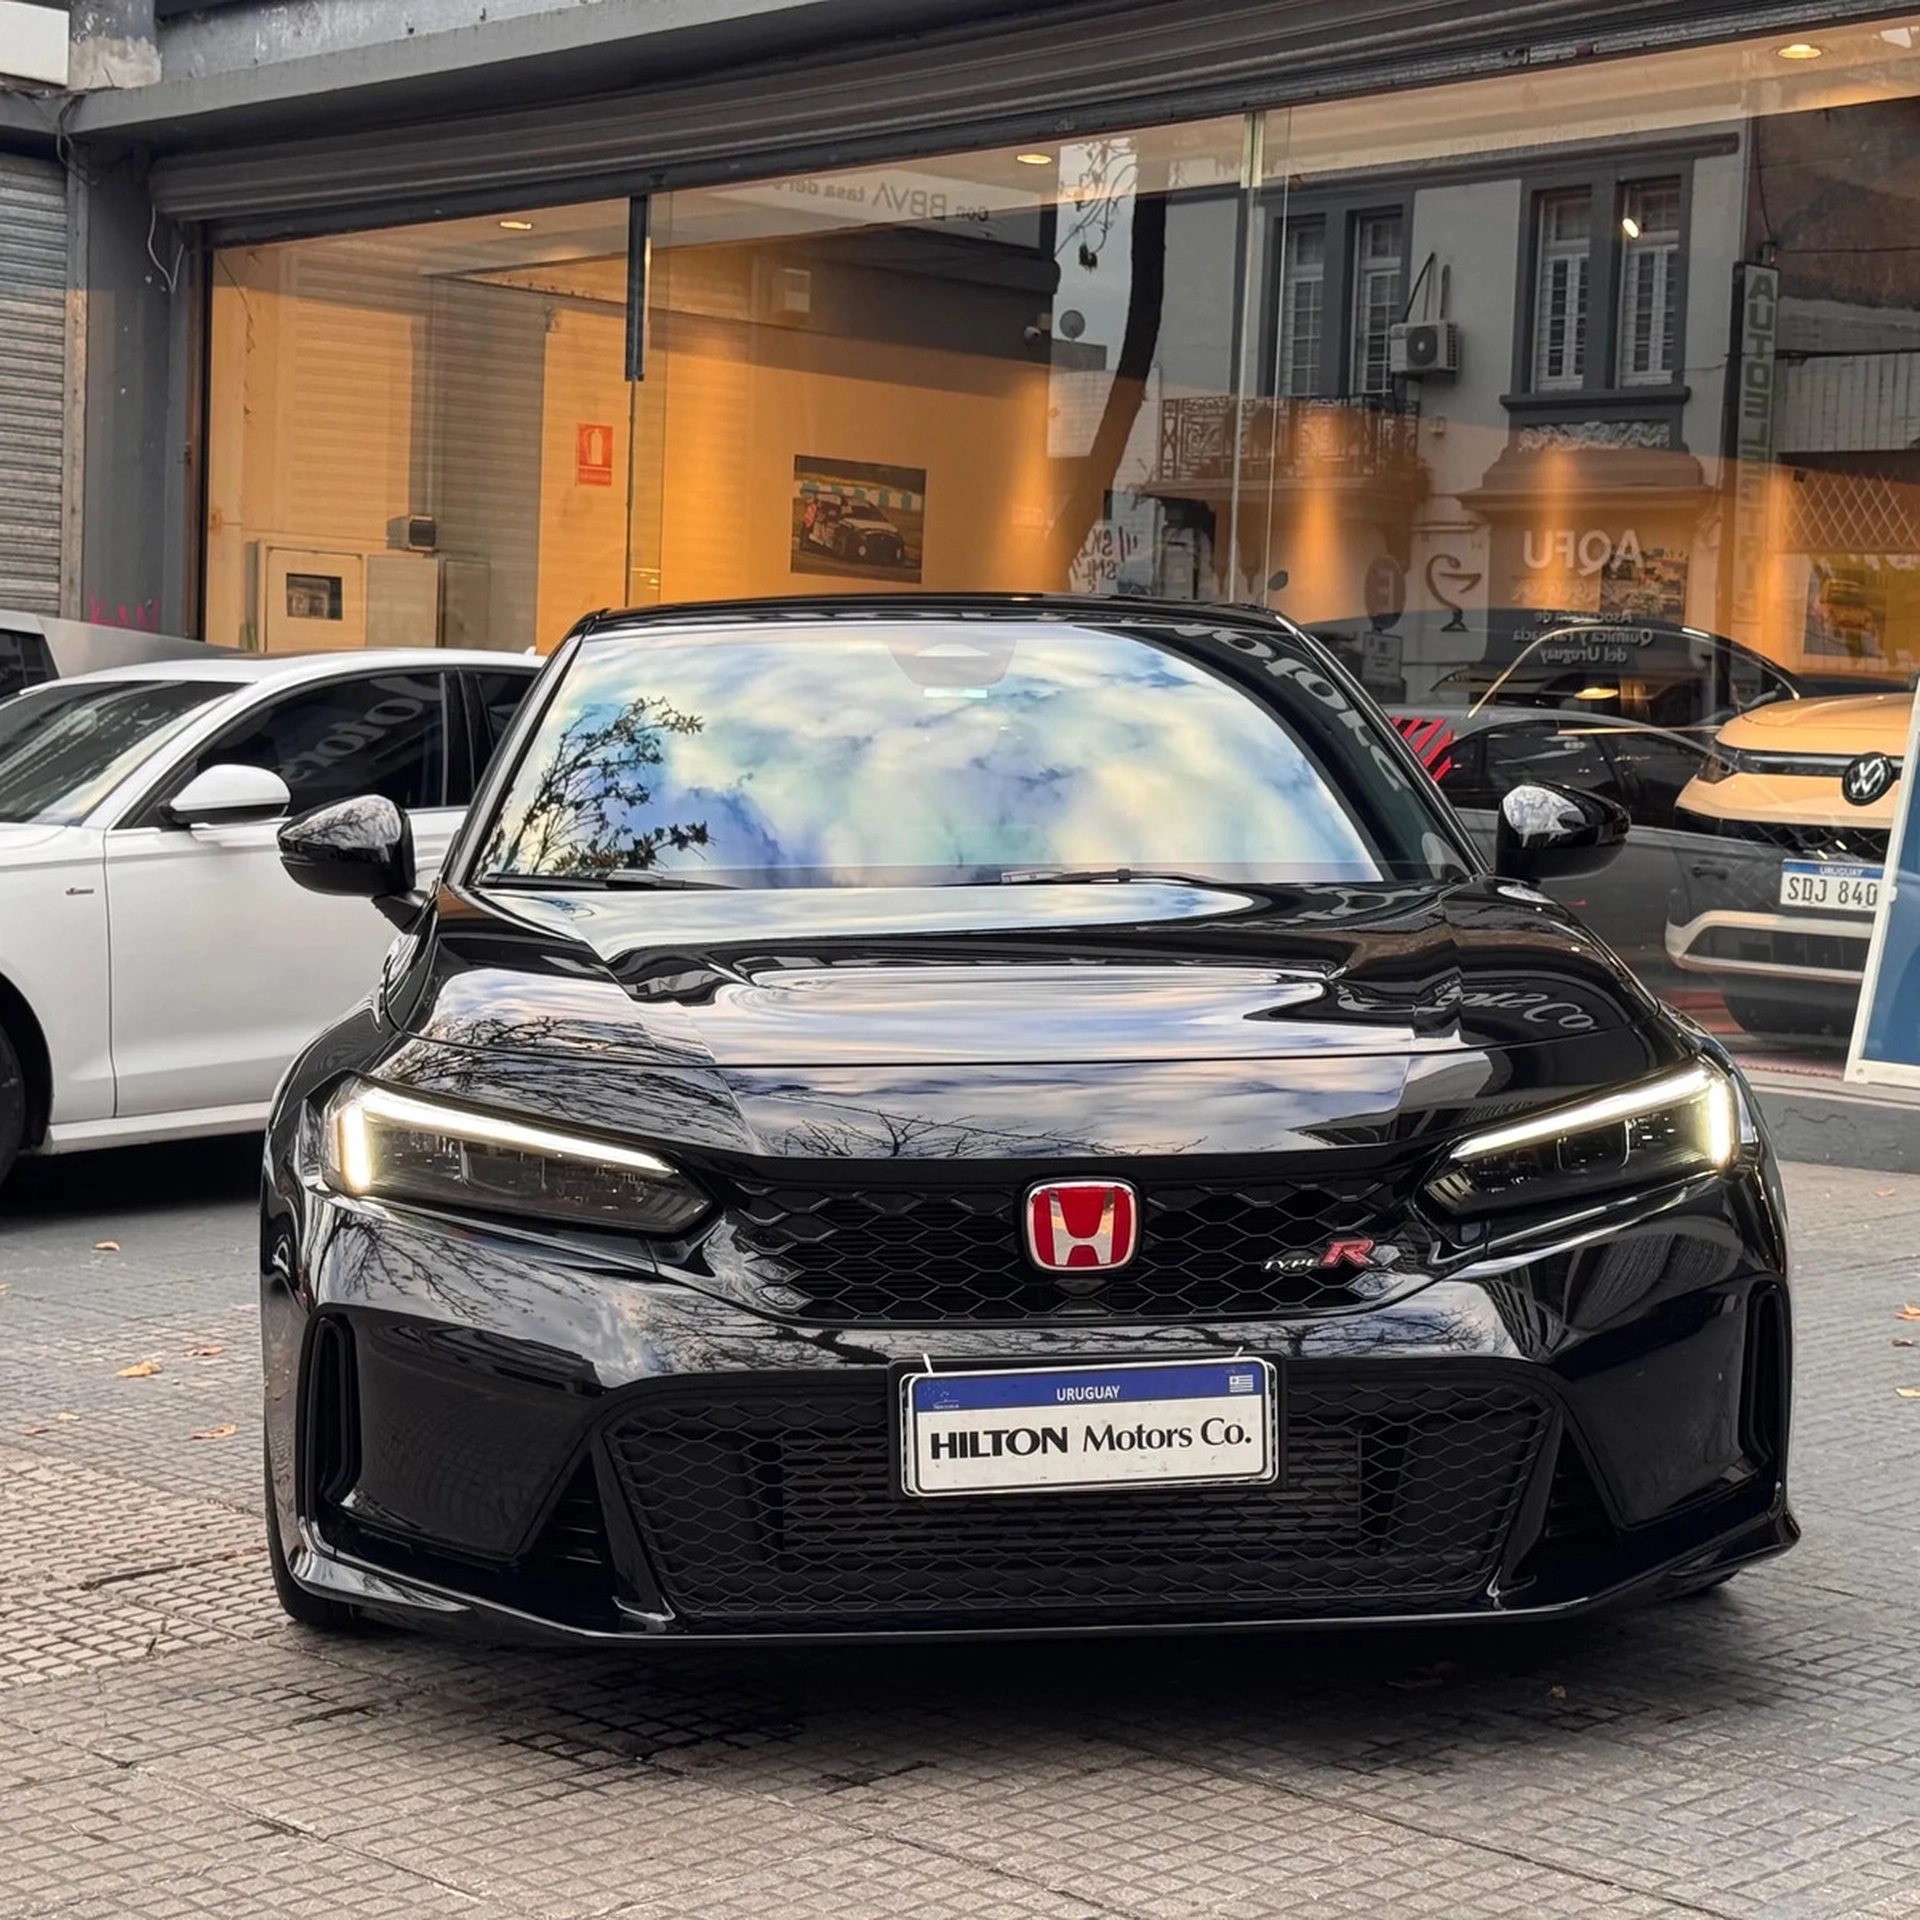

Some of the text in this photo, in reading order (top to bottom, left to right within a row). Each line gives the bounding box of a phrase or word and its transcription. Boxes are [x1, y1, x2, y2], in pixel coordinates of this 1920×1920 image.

[1787, 876, 1828, 904] SDJ
[1320, 1239, 1376, 1268] R
[1056, 1385, 1121, 1401] URUGUAY
[931, 1417, 1253, 1460] HILTON Motors Co.
